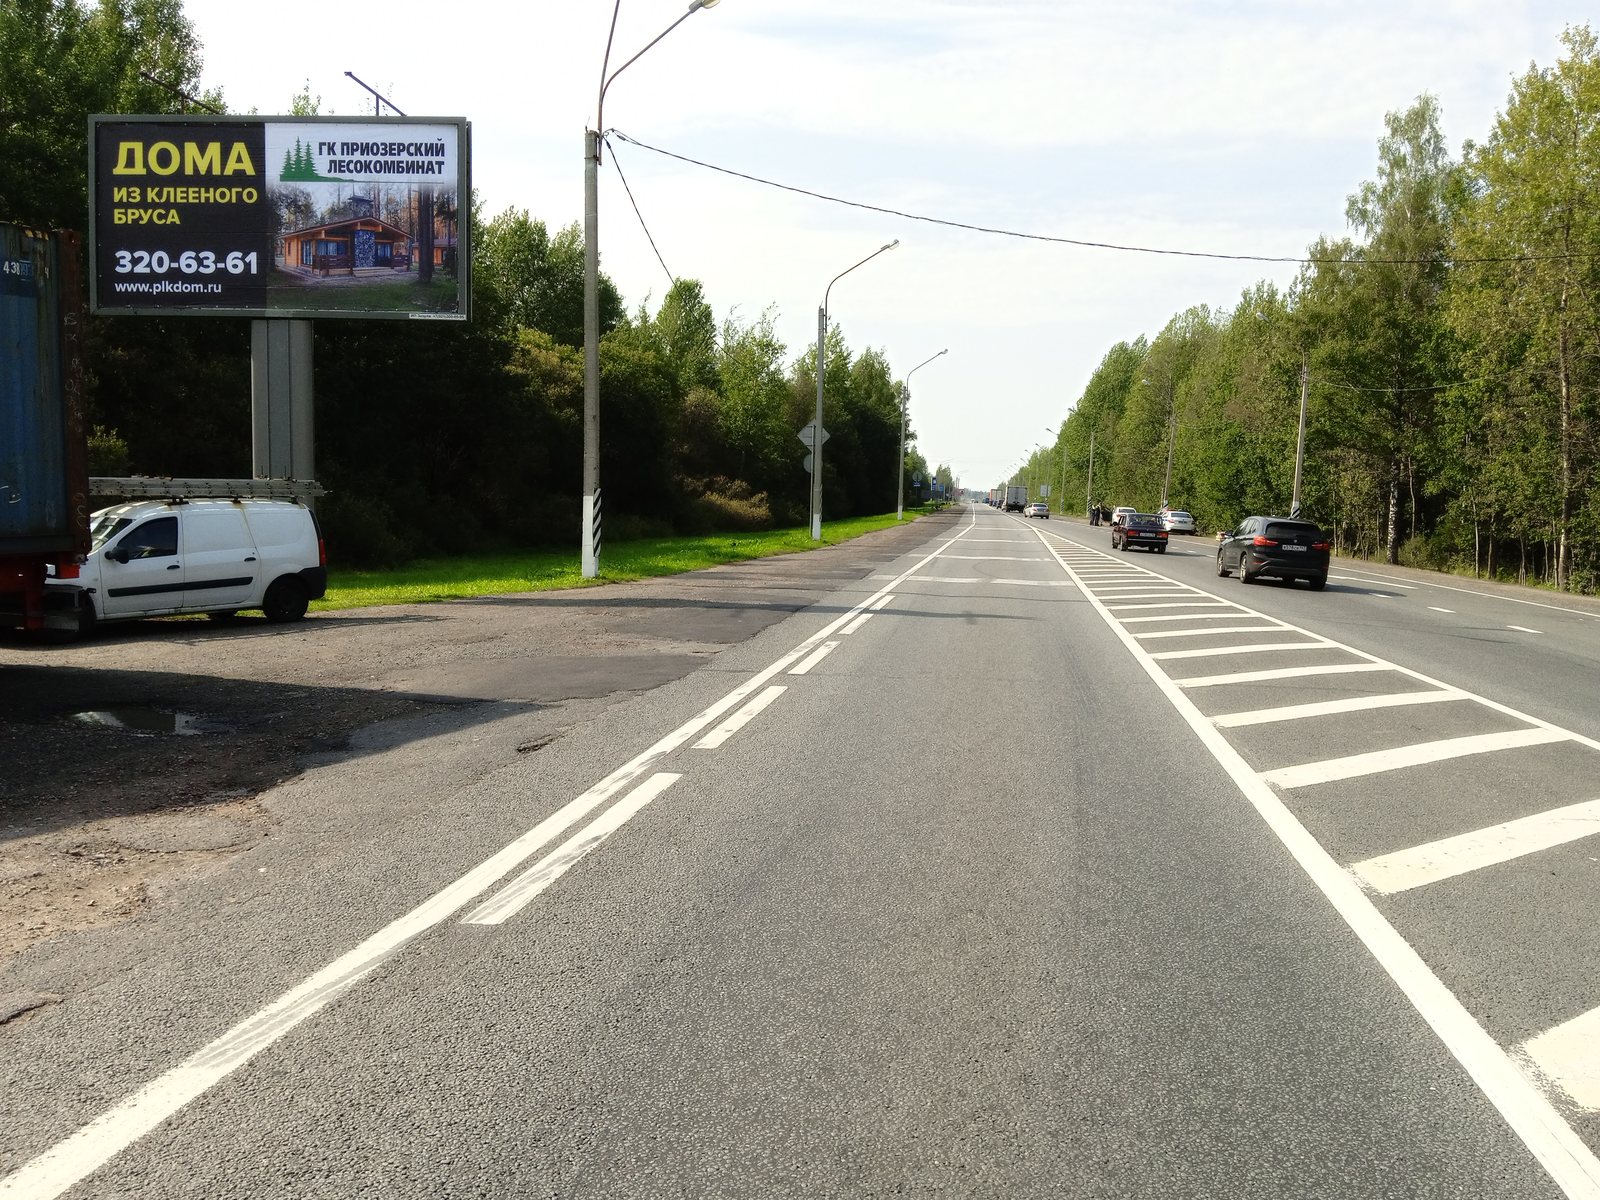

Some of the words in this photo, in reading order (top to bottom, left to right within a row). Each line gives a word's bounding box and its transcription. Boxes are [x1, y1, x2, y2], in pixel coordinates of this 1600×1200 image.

[318, 141, 337, 156] ГК
[340, 138, 445, 157] ПРИОЗЕРСКИЙ
[112, 141, 256, 176] ДОМА
[327, 159, 445, 175] ЛЕСОКОМБИНАТ
[113, 187, 141, 203] ИЗ
[147, 187, 258, 204] КЛЕЕНОГО
[113, 208, 181, 225] БРУСА
[114, 250, 258, 275] 320-63-61
[114, 280, 222, 295] www.plkdom.ru
